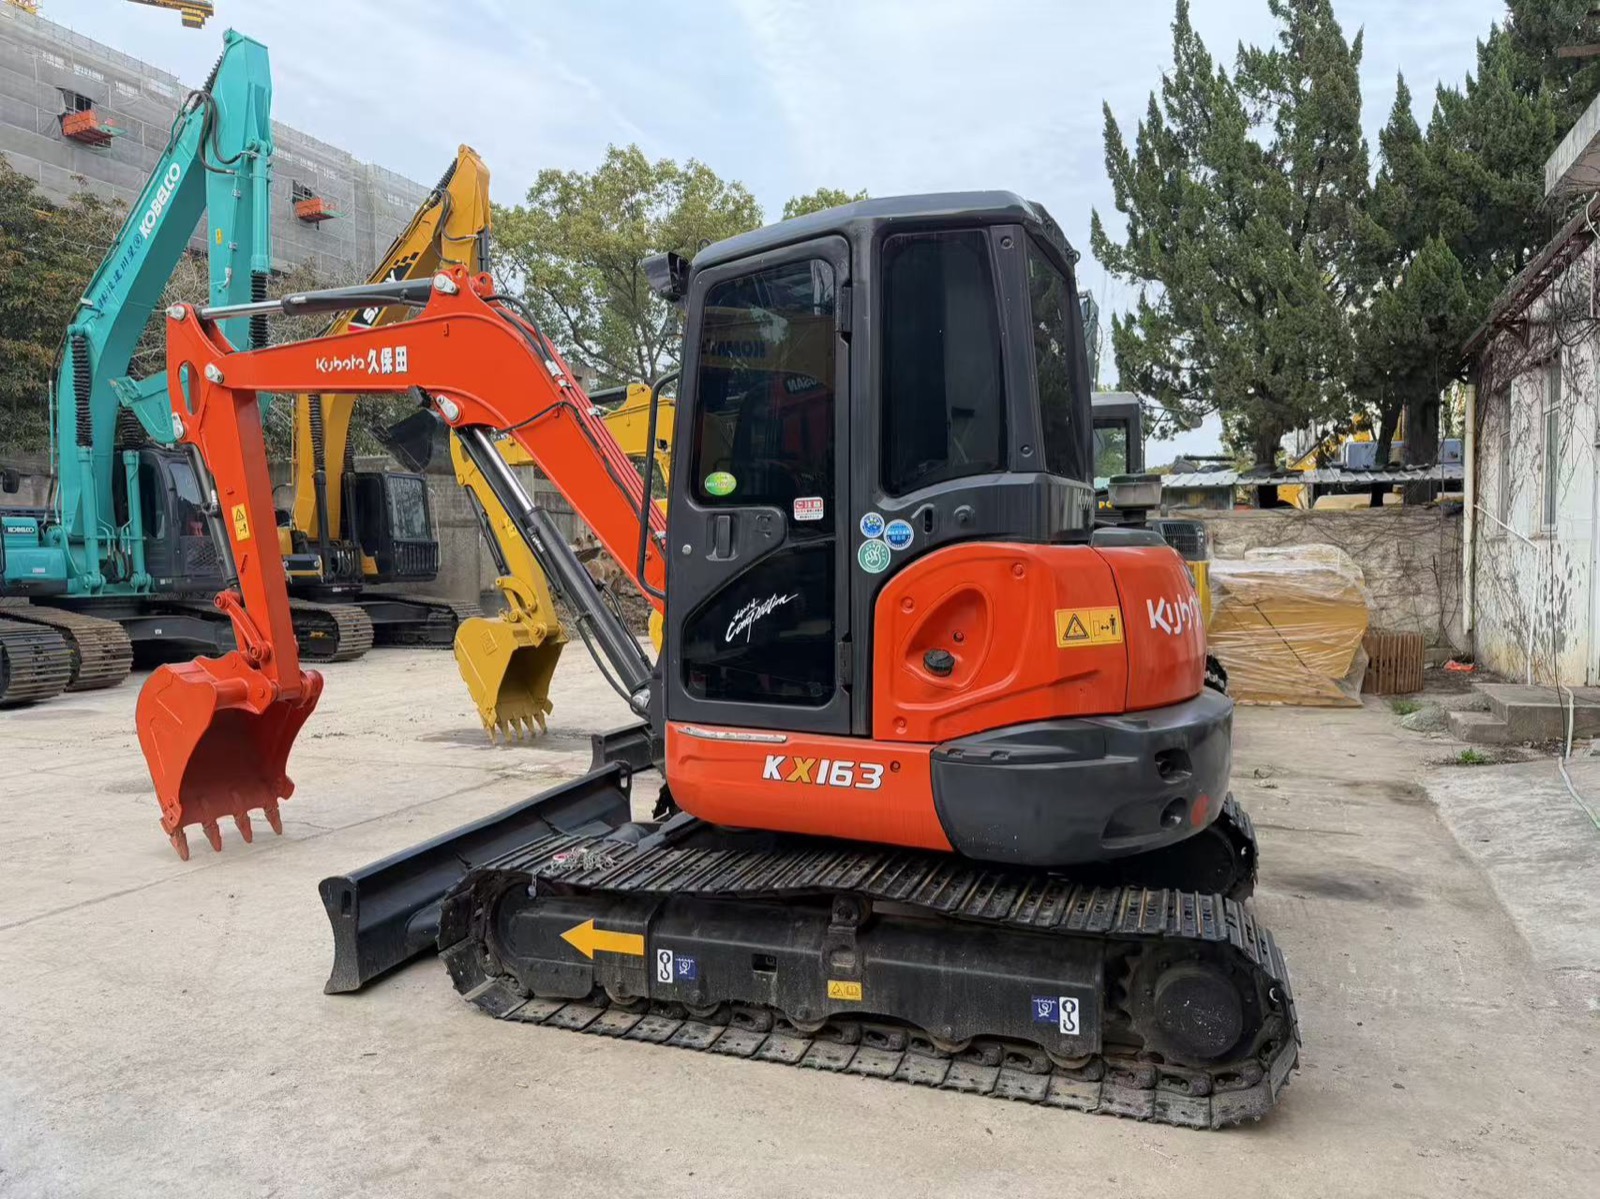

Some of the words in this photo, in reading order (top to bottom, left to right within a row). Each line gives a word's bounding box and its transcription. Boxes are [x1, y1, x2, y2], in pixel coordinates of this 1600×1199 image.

[139, 162, 180, 239] KOBELCO
[316, 354, 365, 372] Kubota
[367, 346, 407, 374] 久保田
[762, 754, 884, 790] KX163
